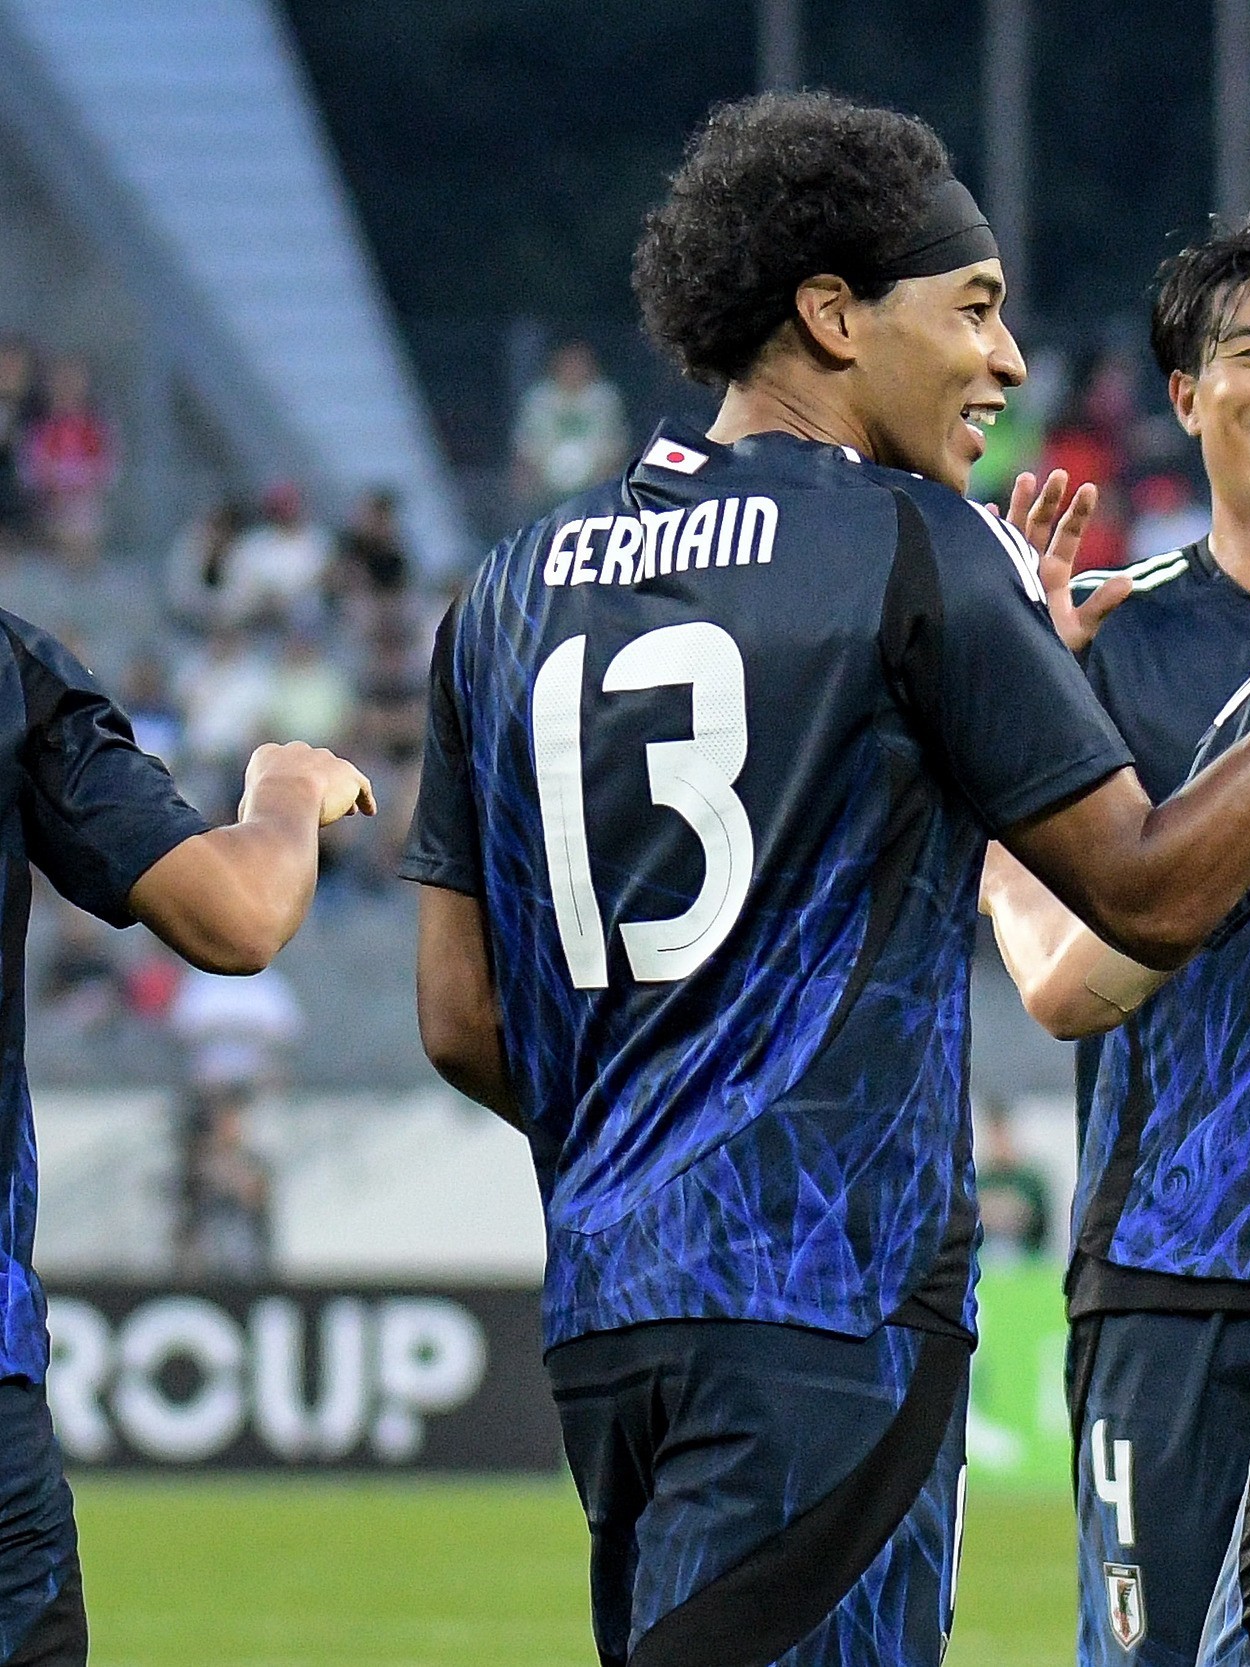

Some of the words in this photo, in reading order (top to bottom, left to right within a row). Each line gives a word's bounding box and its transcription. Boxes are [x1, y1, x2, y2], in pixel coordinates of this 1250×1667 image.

[543, 496, 779, 587] GERMAIN
[532, 621, 754, 989] 13
[47, 1294, 487, 1462] ROUP
[1090, 1419, 1134, 1545] 4
